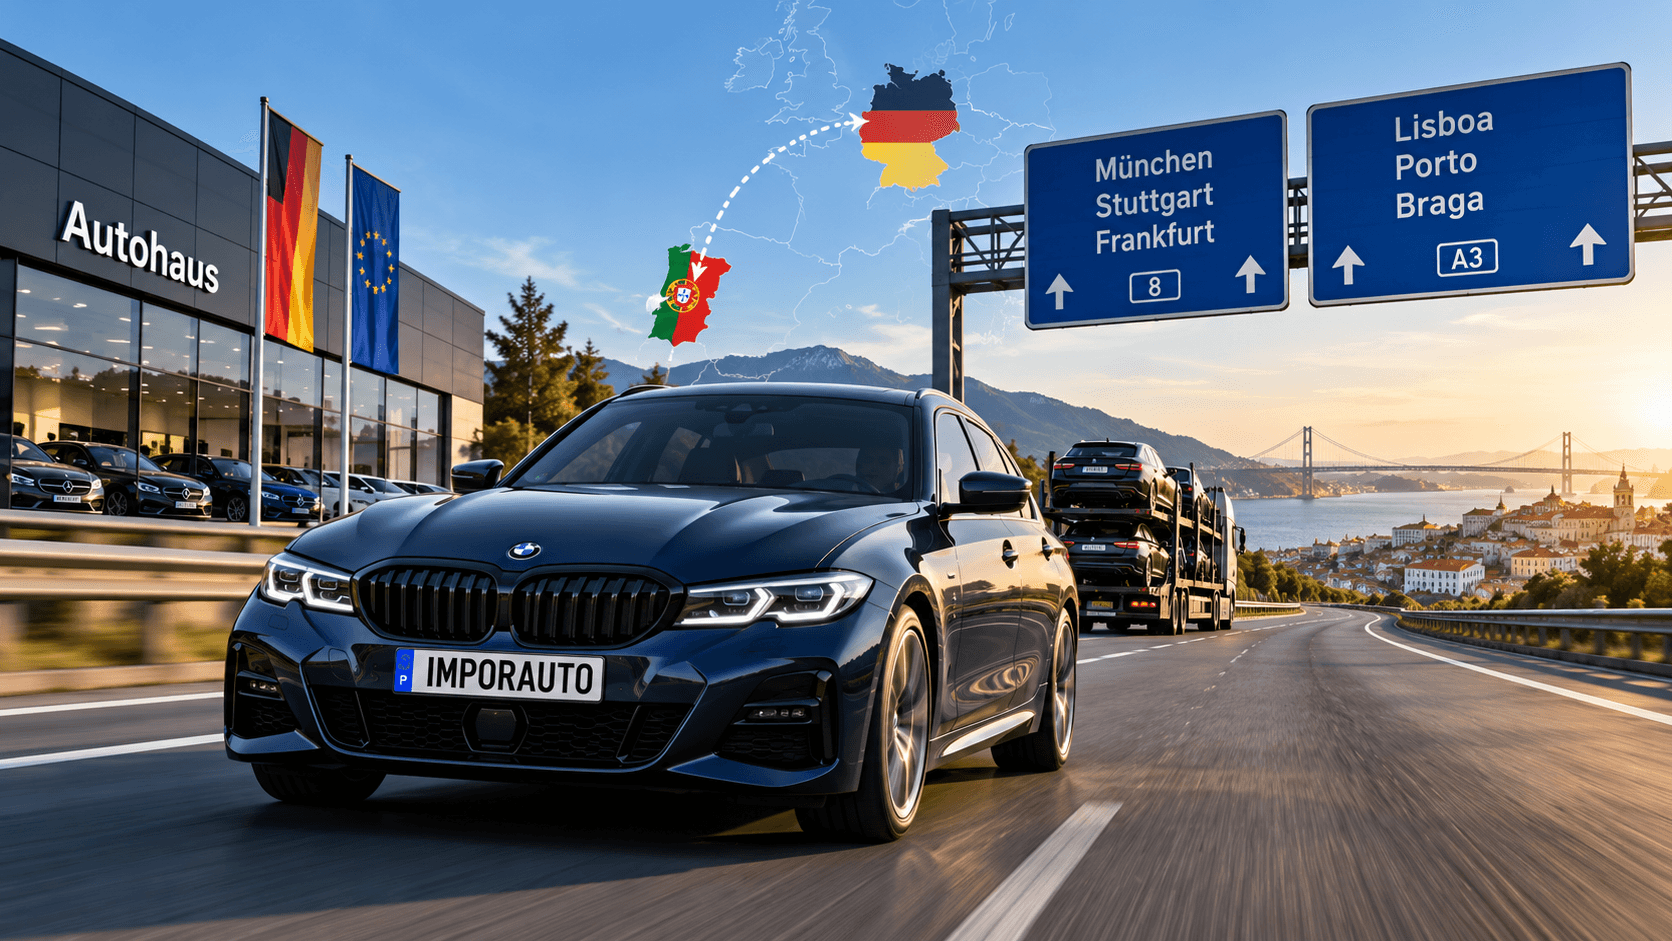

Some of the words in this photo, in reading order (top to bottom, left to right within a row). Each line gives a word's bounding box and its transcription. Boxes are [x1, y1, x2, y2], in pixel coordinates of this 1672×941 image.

[1395, 110, 1494, 142] Lisboa
[1095, 149, 1213, 183] München
[1396, 150, 1477, 181] Porto
[1095, 182, 1214, 218] Stuttgart
[1396, 191, 1484, 220] Braga
[62, 200, 220, 294] Autohaus
[1096, 220, 1215, 255] Frankfurt
[1451, 246, 1484, 270] A3
[1148, 276, 1161, 297] 8
[399, 675, 407, 685] P
[426, 656, 594, 695] IMPORAUTO
